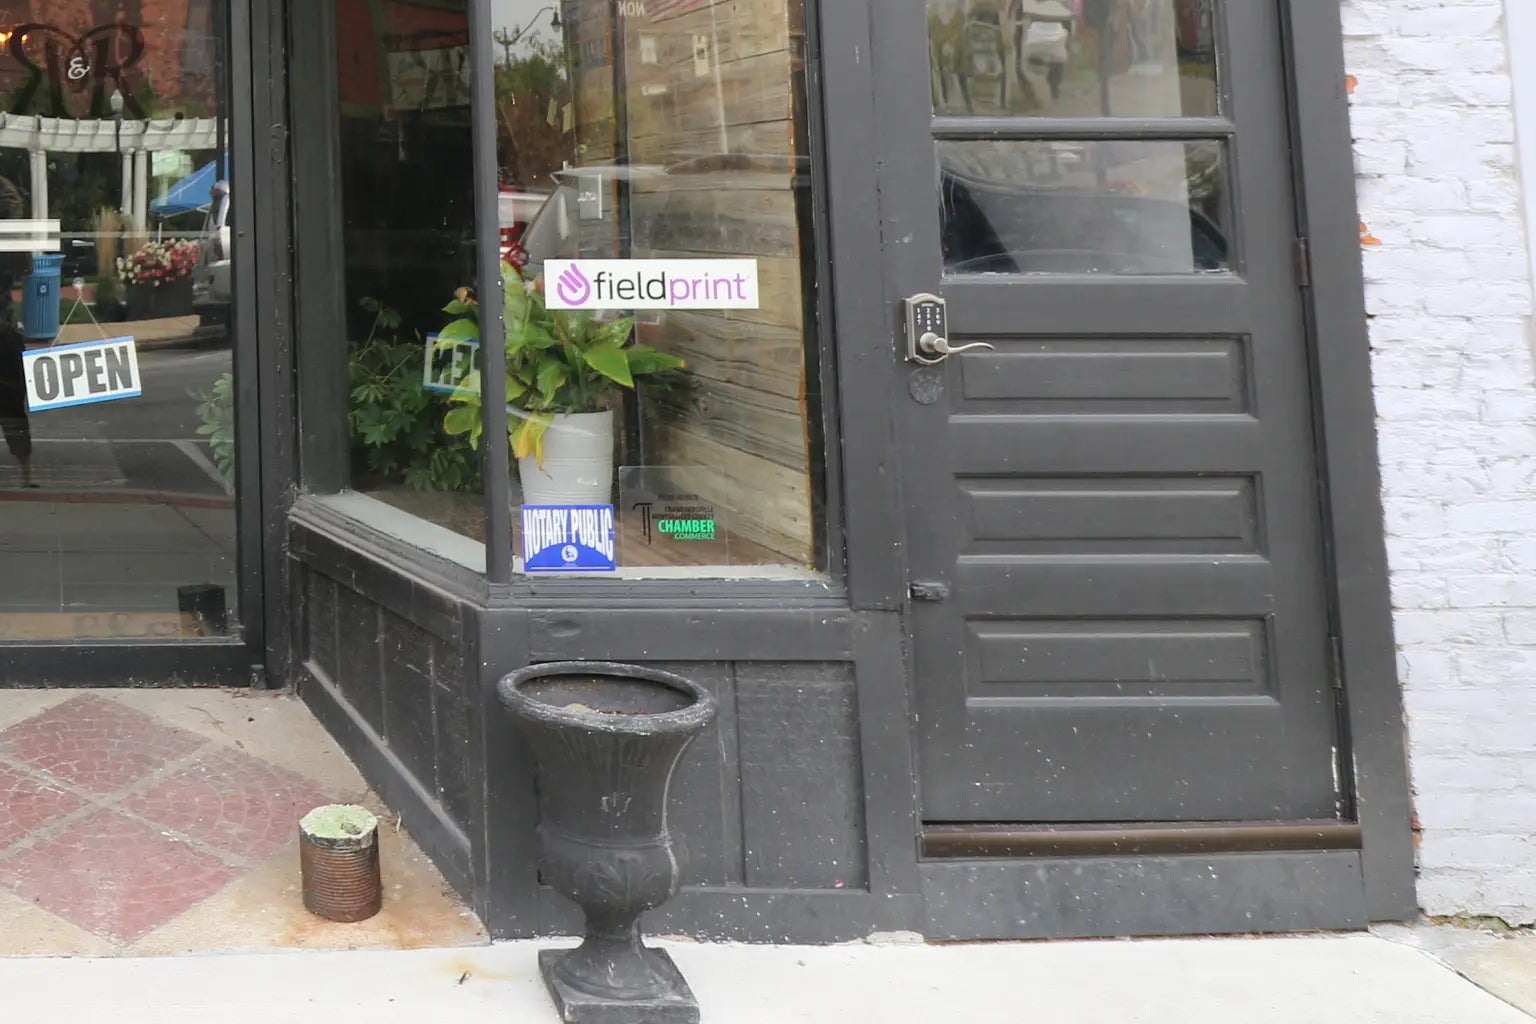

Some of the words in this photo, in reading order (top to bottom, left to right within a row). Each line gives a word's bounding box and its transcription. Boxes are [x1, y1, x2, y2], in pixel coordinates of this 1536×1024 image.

[593, 271, 747, 306] fieldprint
[33, 346, 133, 401] OPEN
[523, 508, 567, 564] NOTARY
[570, 508, 614, 562] PUBLIC
[657, 519, 715, 533] CHAMBER
[674, 532, 716, 540] COMMERCE
